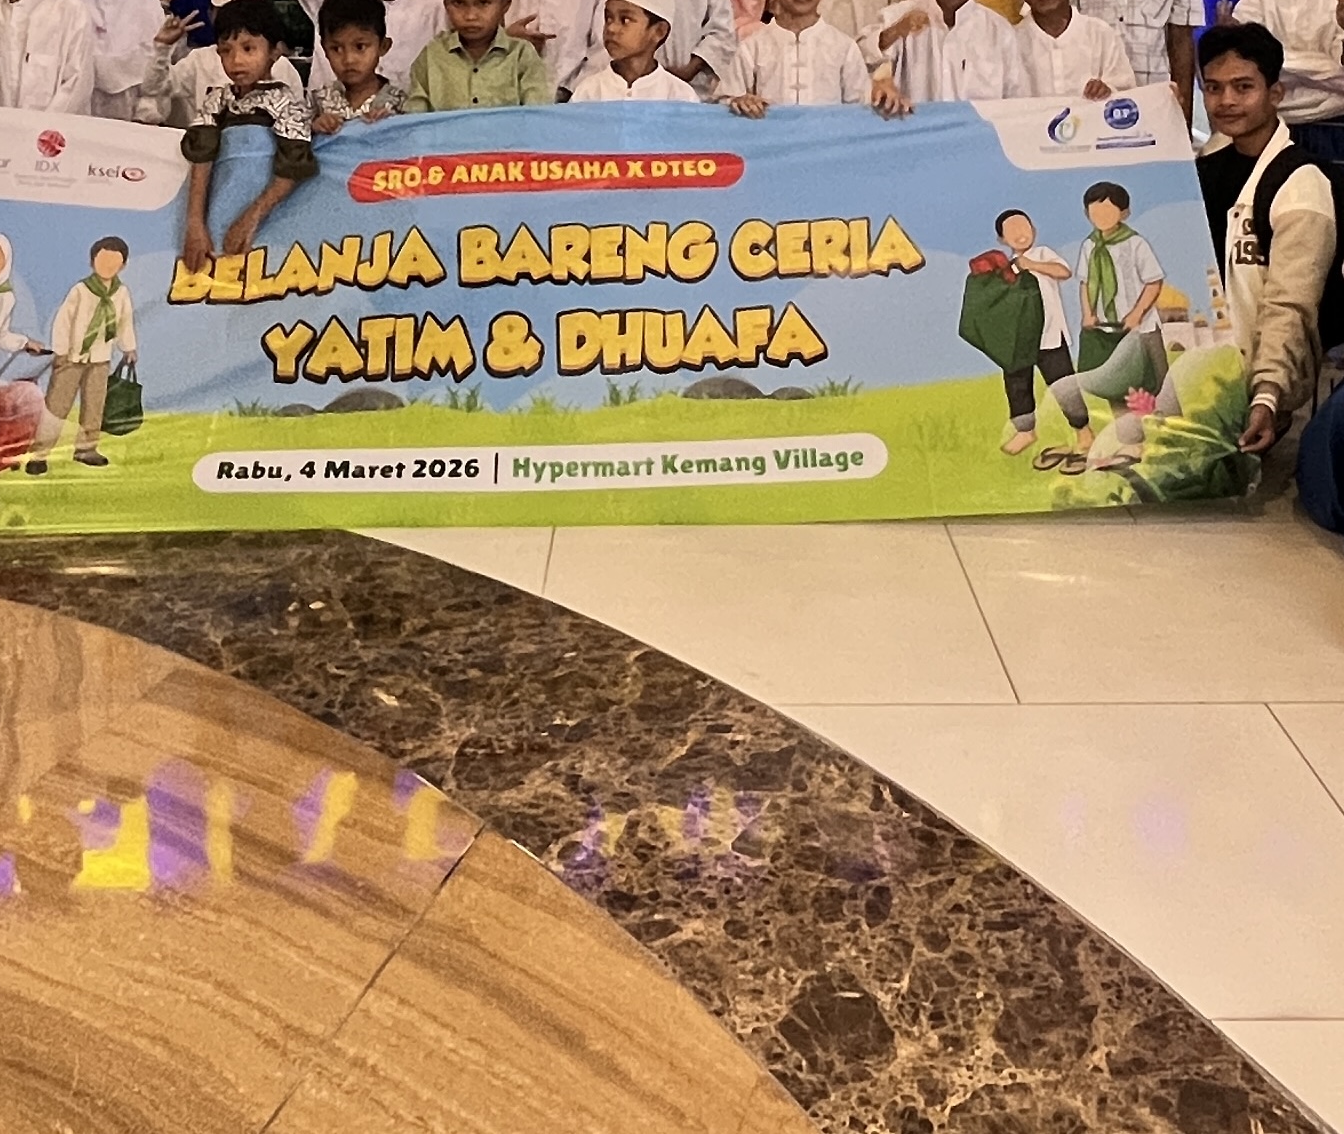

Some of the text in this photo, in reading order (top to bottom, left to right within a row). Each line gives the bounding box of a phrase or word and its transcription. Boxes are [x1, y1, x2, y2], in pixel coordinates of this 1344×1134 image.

[35, 160, 61, 173] IDX
[88, 164, 121, 179] ksei
[372, 158, 717, 191] SRO & ANAK USAHA X DTEO
[168, 213, 927, 305] BELANJA BARENG CERIA
[260, 299, 829, 384] YATIM & DHUAFA
[216, 457, 481, 482] Rabu, 4 Maret 2026
[512, 447, 864, 484] Hypermart Kemang Village
